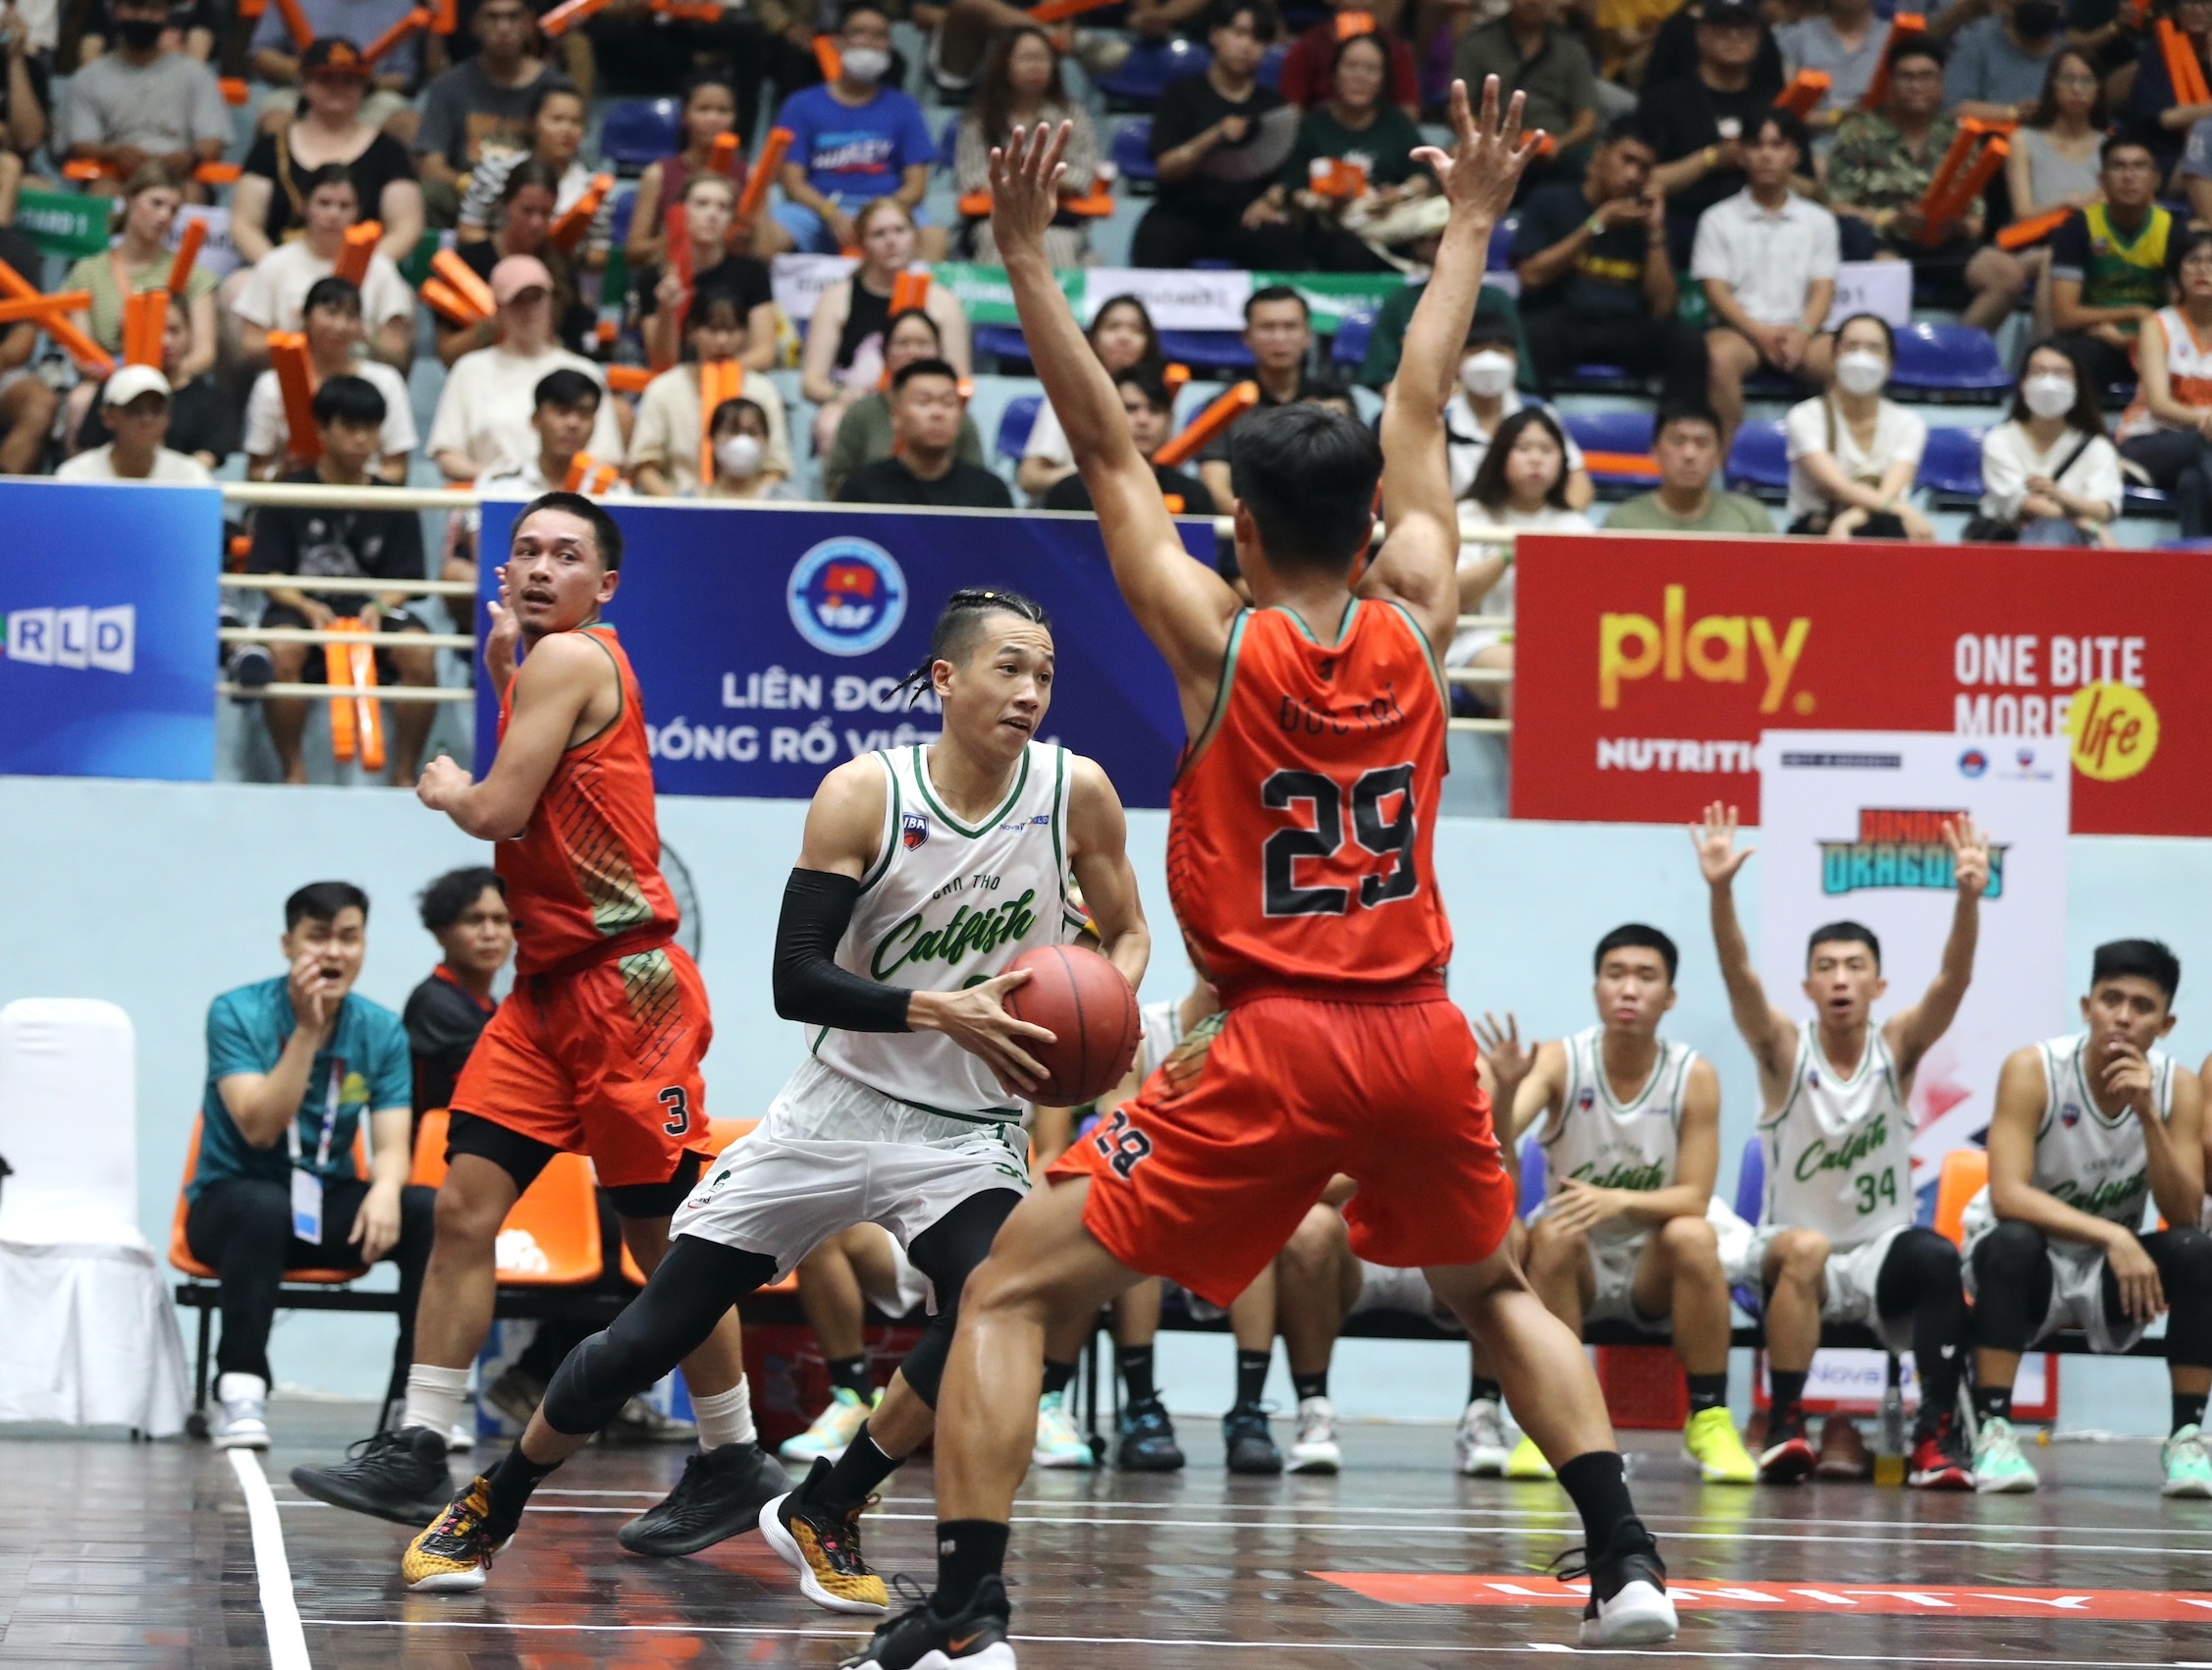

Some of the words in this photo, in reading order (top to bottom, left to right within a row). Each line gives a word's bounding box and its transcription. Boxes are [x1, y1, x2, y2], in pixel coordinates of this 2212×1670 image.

[1954, 633, 2038, 686] ONE
[2049, 634, 2145, 688] BITE
[722, 665, 823, 711] LIÊN
[1954, 692, 2072, 737] MORE
[2077, 689, 2141, 771] life
[1261, 761, 1421, 918] 29
[870, 889, 1038, 982] Catfish
[658, 1085, 689, 1137] 3
[1855, 1165, 1897, 1215] 34
